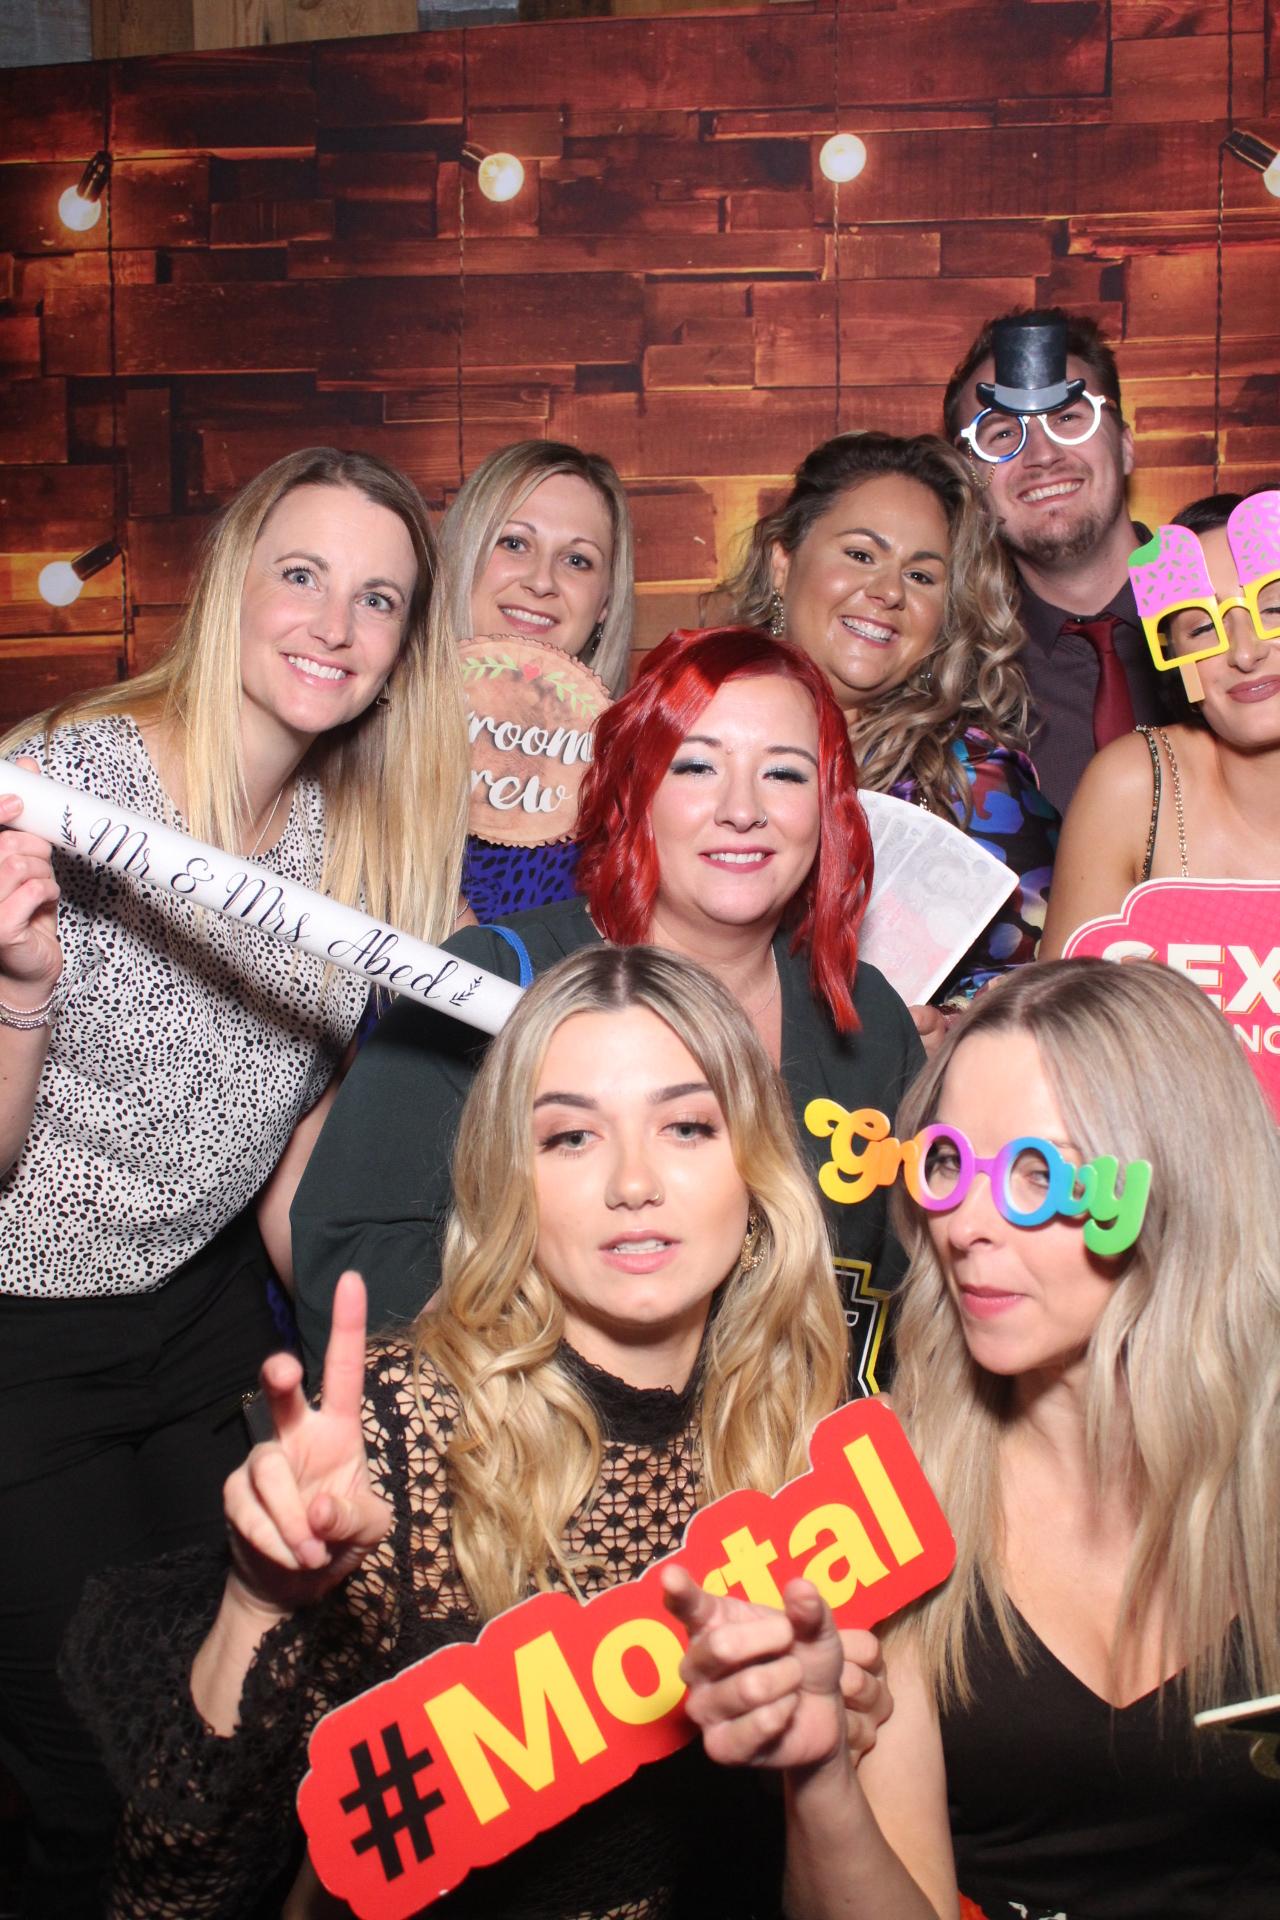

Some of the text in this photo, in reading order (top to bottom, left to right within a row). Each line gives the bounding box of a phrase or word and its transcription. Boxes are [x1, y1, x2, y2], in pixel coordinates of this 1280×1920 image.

[467, 711, 594, 765] room
[470, 769, 574, 813] rew
[88, 818, 459, 999] Mr & Mrs Abed
[338, 1433, 924, 1882] #Motal
